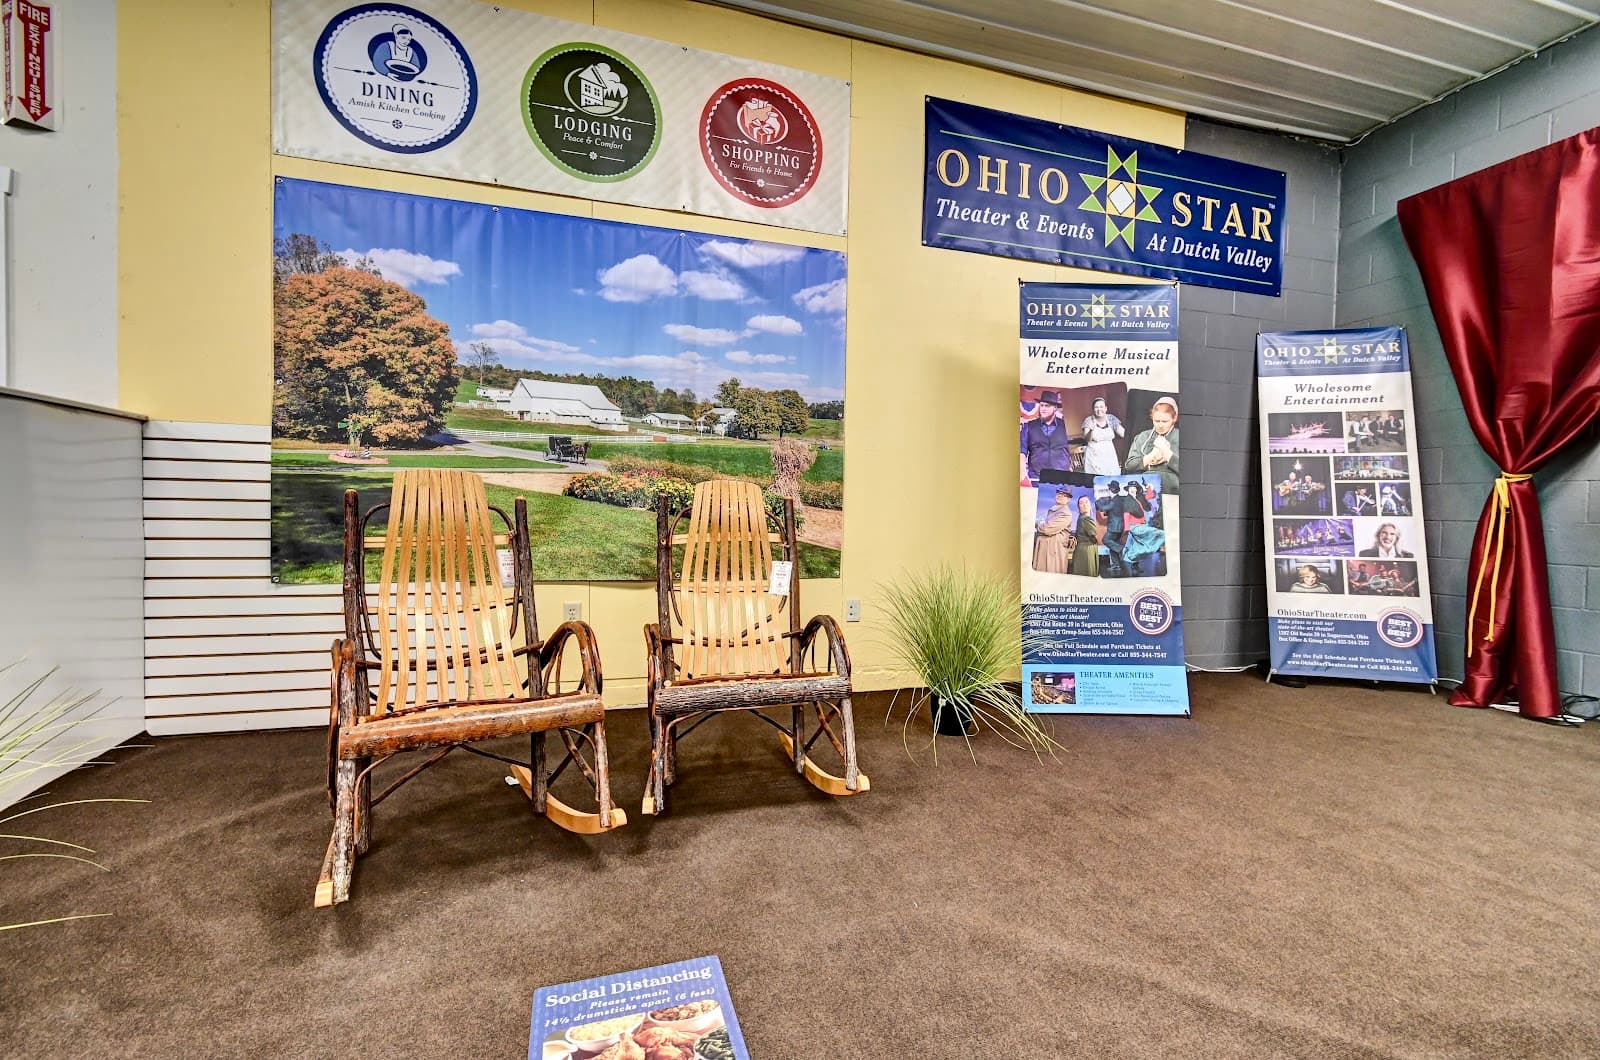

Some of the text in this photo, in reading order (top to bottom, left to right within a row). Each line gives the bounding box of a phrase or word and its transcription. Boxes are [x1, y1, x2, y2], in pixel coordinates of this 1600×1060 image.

[20, 2, 48, 25] FIRE
[29, 22, 41, 116] EXTINGUISHER
[362, 81, 434, 107] DINING
[348, 97, 446, 121] Amish Kitchen Cooking
[554, 114, 632, 141] LODGING
[563, 132, 623, 150] Peace & Comfort
[722, 143, 800, 169] SHOPPING
[729, 160, 793, 178] For Friends & Home
[936, 149, 1069, 205] OHIO
[1172, 191, 1274, 243] STAR
[936, 198, 1273, 273] Theater & Events At Dutch Valley
[1026, 302, 1170, 318] OHIO STAR
[1026, 319, 1054, 327] Theater
[1147, 321, 1170, 330] Valley
[1027, 346, 1170, 361] Wholesome Musical
[1264, 342, 1400, 358] OHIO STAR
[1378, 354, 1401, 362] Valley
[1046, 361, 1150, 376] Entertainment
[1295, 383, 1372, 393] Wholesome
[1284, 394, 1385, 406] Entertainment
[1029, 593, 1123, 604] OhioStarTheater.com
[1140, 601, 1163, 611] BEST
[1139, 614, 1162, 625] BEST
[1277, 608, 1367, 620] OhioStarTheater.com
[1388, 618, 1412, 628] BEST
[1387, 629, 1411, 638] BEST
[1080, 671, 1154, 679] THEATER AMENITIES
[545, 966, 712, 1008] Social Distancing
[574, 1004, 637, 1023] drumsticks
[641, 995, 671, 1009] apart
[675, 992, 687, 1002] (6
[690, 986, 716, 999] feet)
[590, 989, 669, 1010] Please remain
